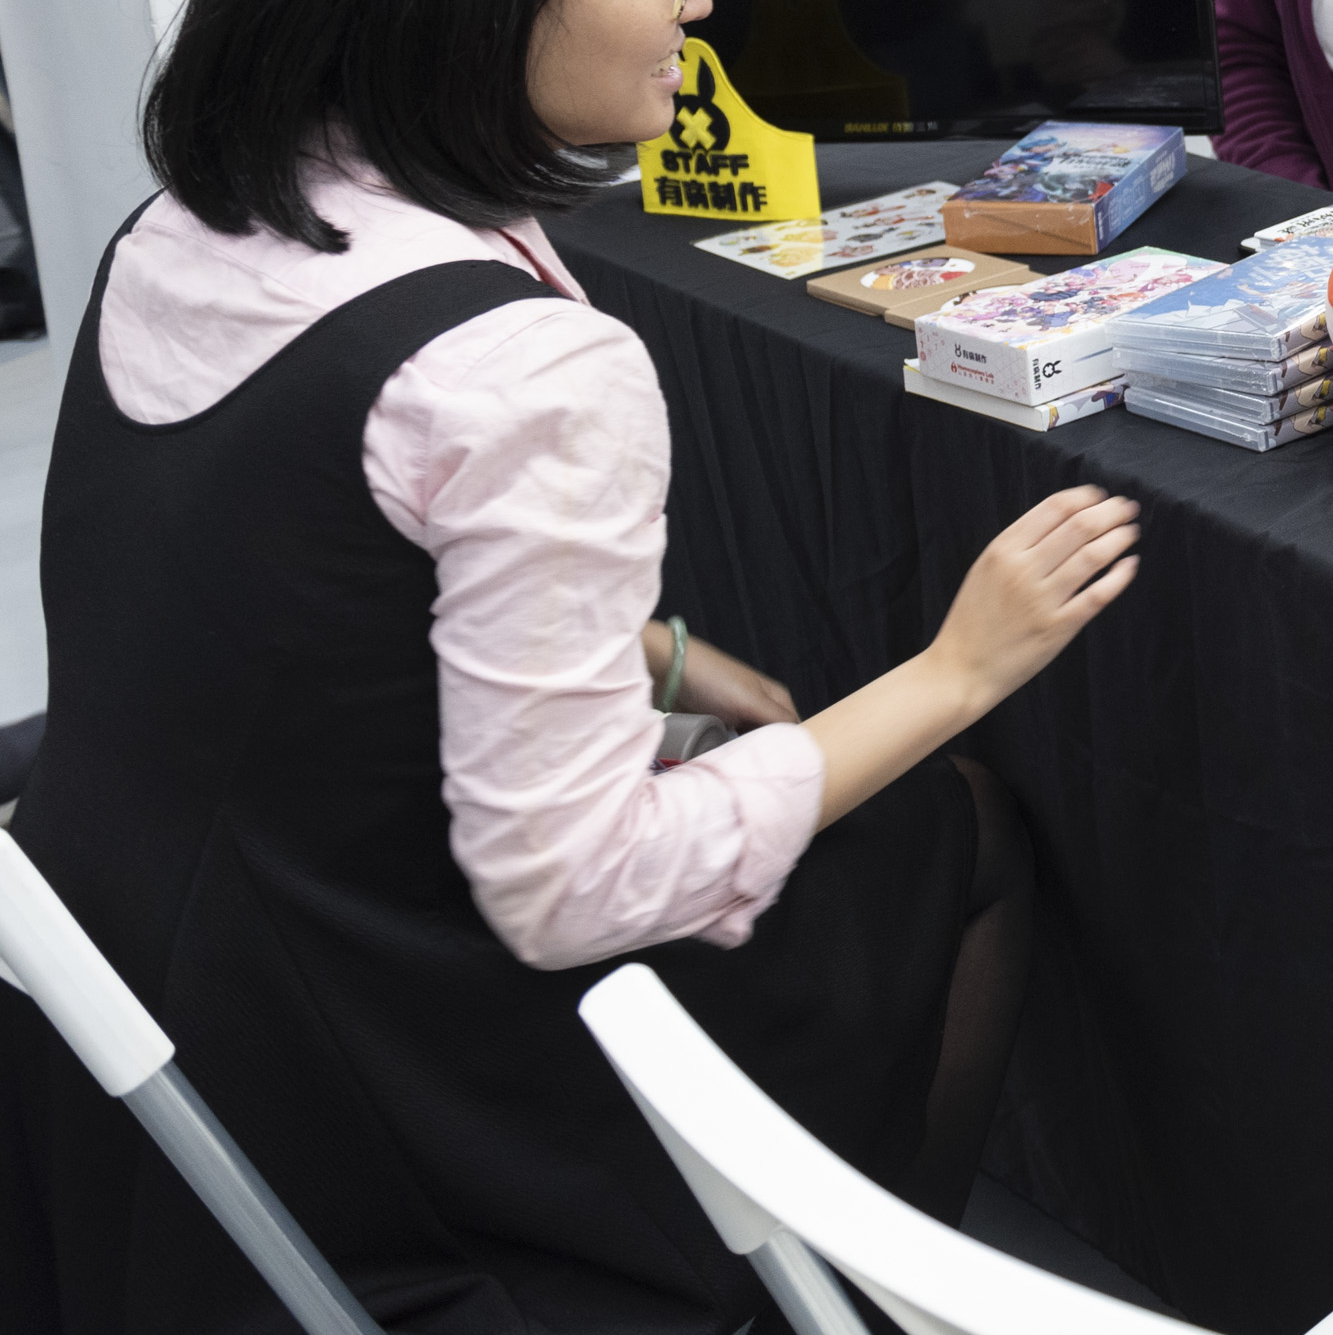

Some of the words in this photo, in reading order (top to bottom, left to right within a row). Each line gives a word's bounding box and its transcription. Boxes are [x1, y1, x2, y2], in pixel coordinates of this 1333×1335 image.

[661, 149, 749, 176] STAFF
[654, 176, 768, 212] 有病制作
